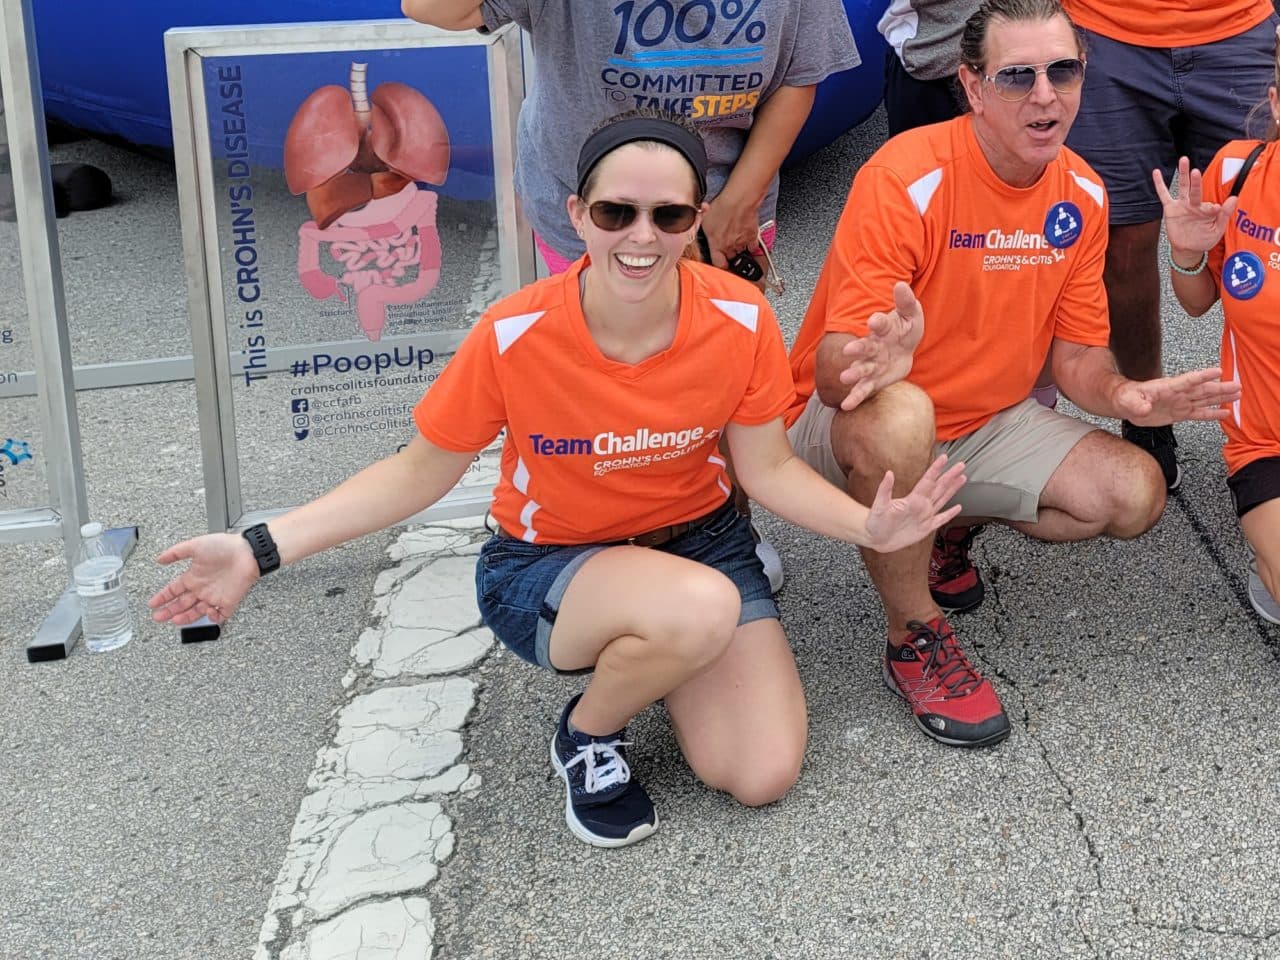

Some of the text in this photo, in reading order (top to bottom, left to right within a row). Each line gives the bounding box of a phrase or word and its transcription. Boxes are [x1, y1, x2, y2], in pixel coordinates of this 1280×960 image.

[600, 68, 764, 95] COMMITTED
[600, 87, 627, 103] TO
[217, 64, 267, 387] This is CROHN'S DISEASE
[289, 345, 435, 378] #PoopUp
